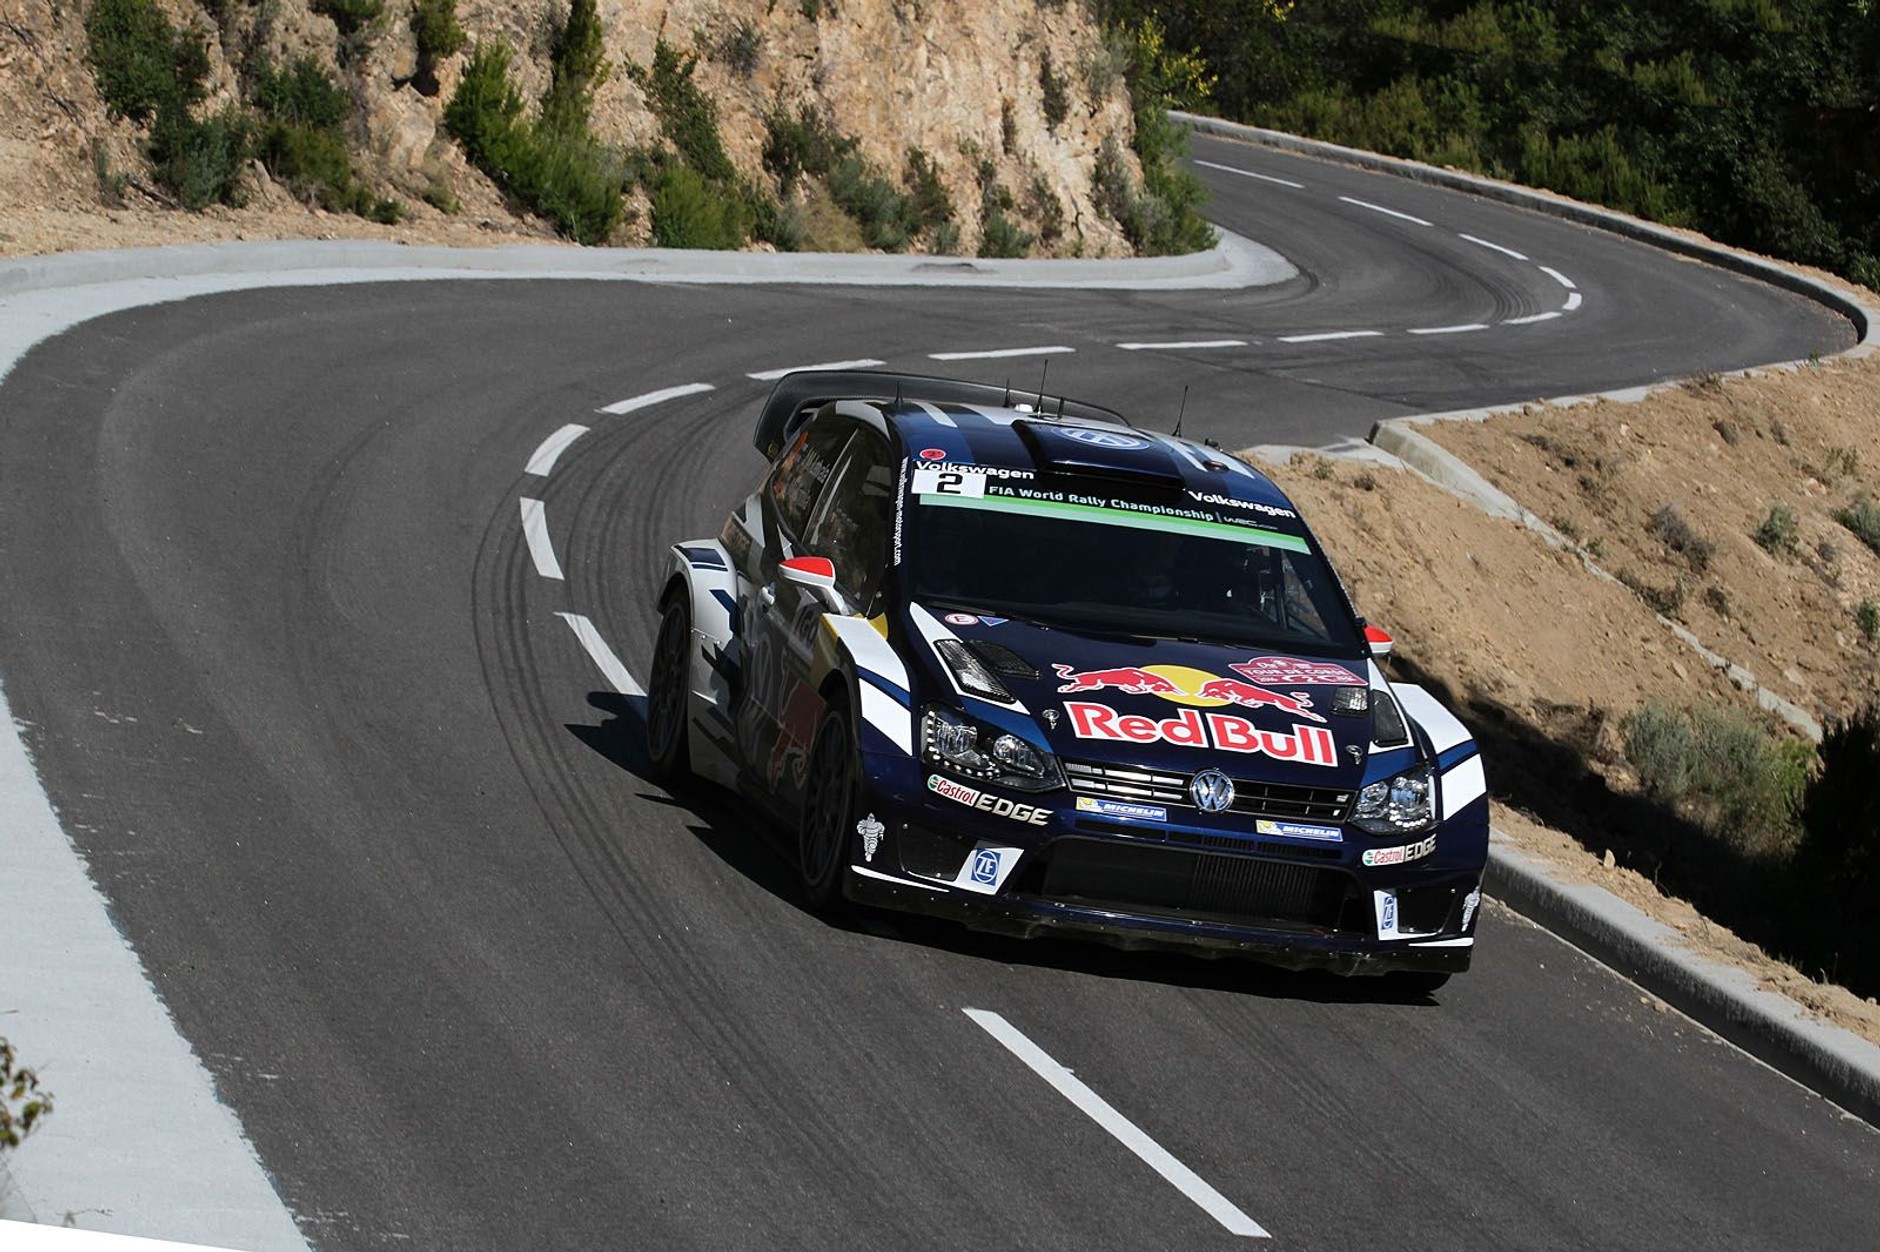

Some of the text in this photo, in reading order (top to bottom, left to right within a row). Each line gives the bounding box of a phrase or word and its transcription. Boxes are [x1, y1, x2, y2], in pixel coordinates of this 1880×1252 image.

[916, 460, 1035, 480] Volkswagen
[936, 473, 964, 494] 2
[989, 486, 1015, 496] FIA
[1018, 488, 1064, 501] World
[1068, 494, 1106, 508] Rally
[1111, 499, 1214, 522] Championship
[1188, 490, 1296, 519] Volkswagen
[1064, 702, 1337, 767] Red Bull
[936, 779, 1054, 826] Castrol EDGE
[1103, 803, 1164, 817] MICHELIN
[1282, 825, 1340, 837] MICHELIN
[1373, 833, 1437, 864] Castrol EDGE
